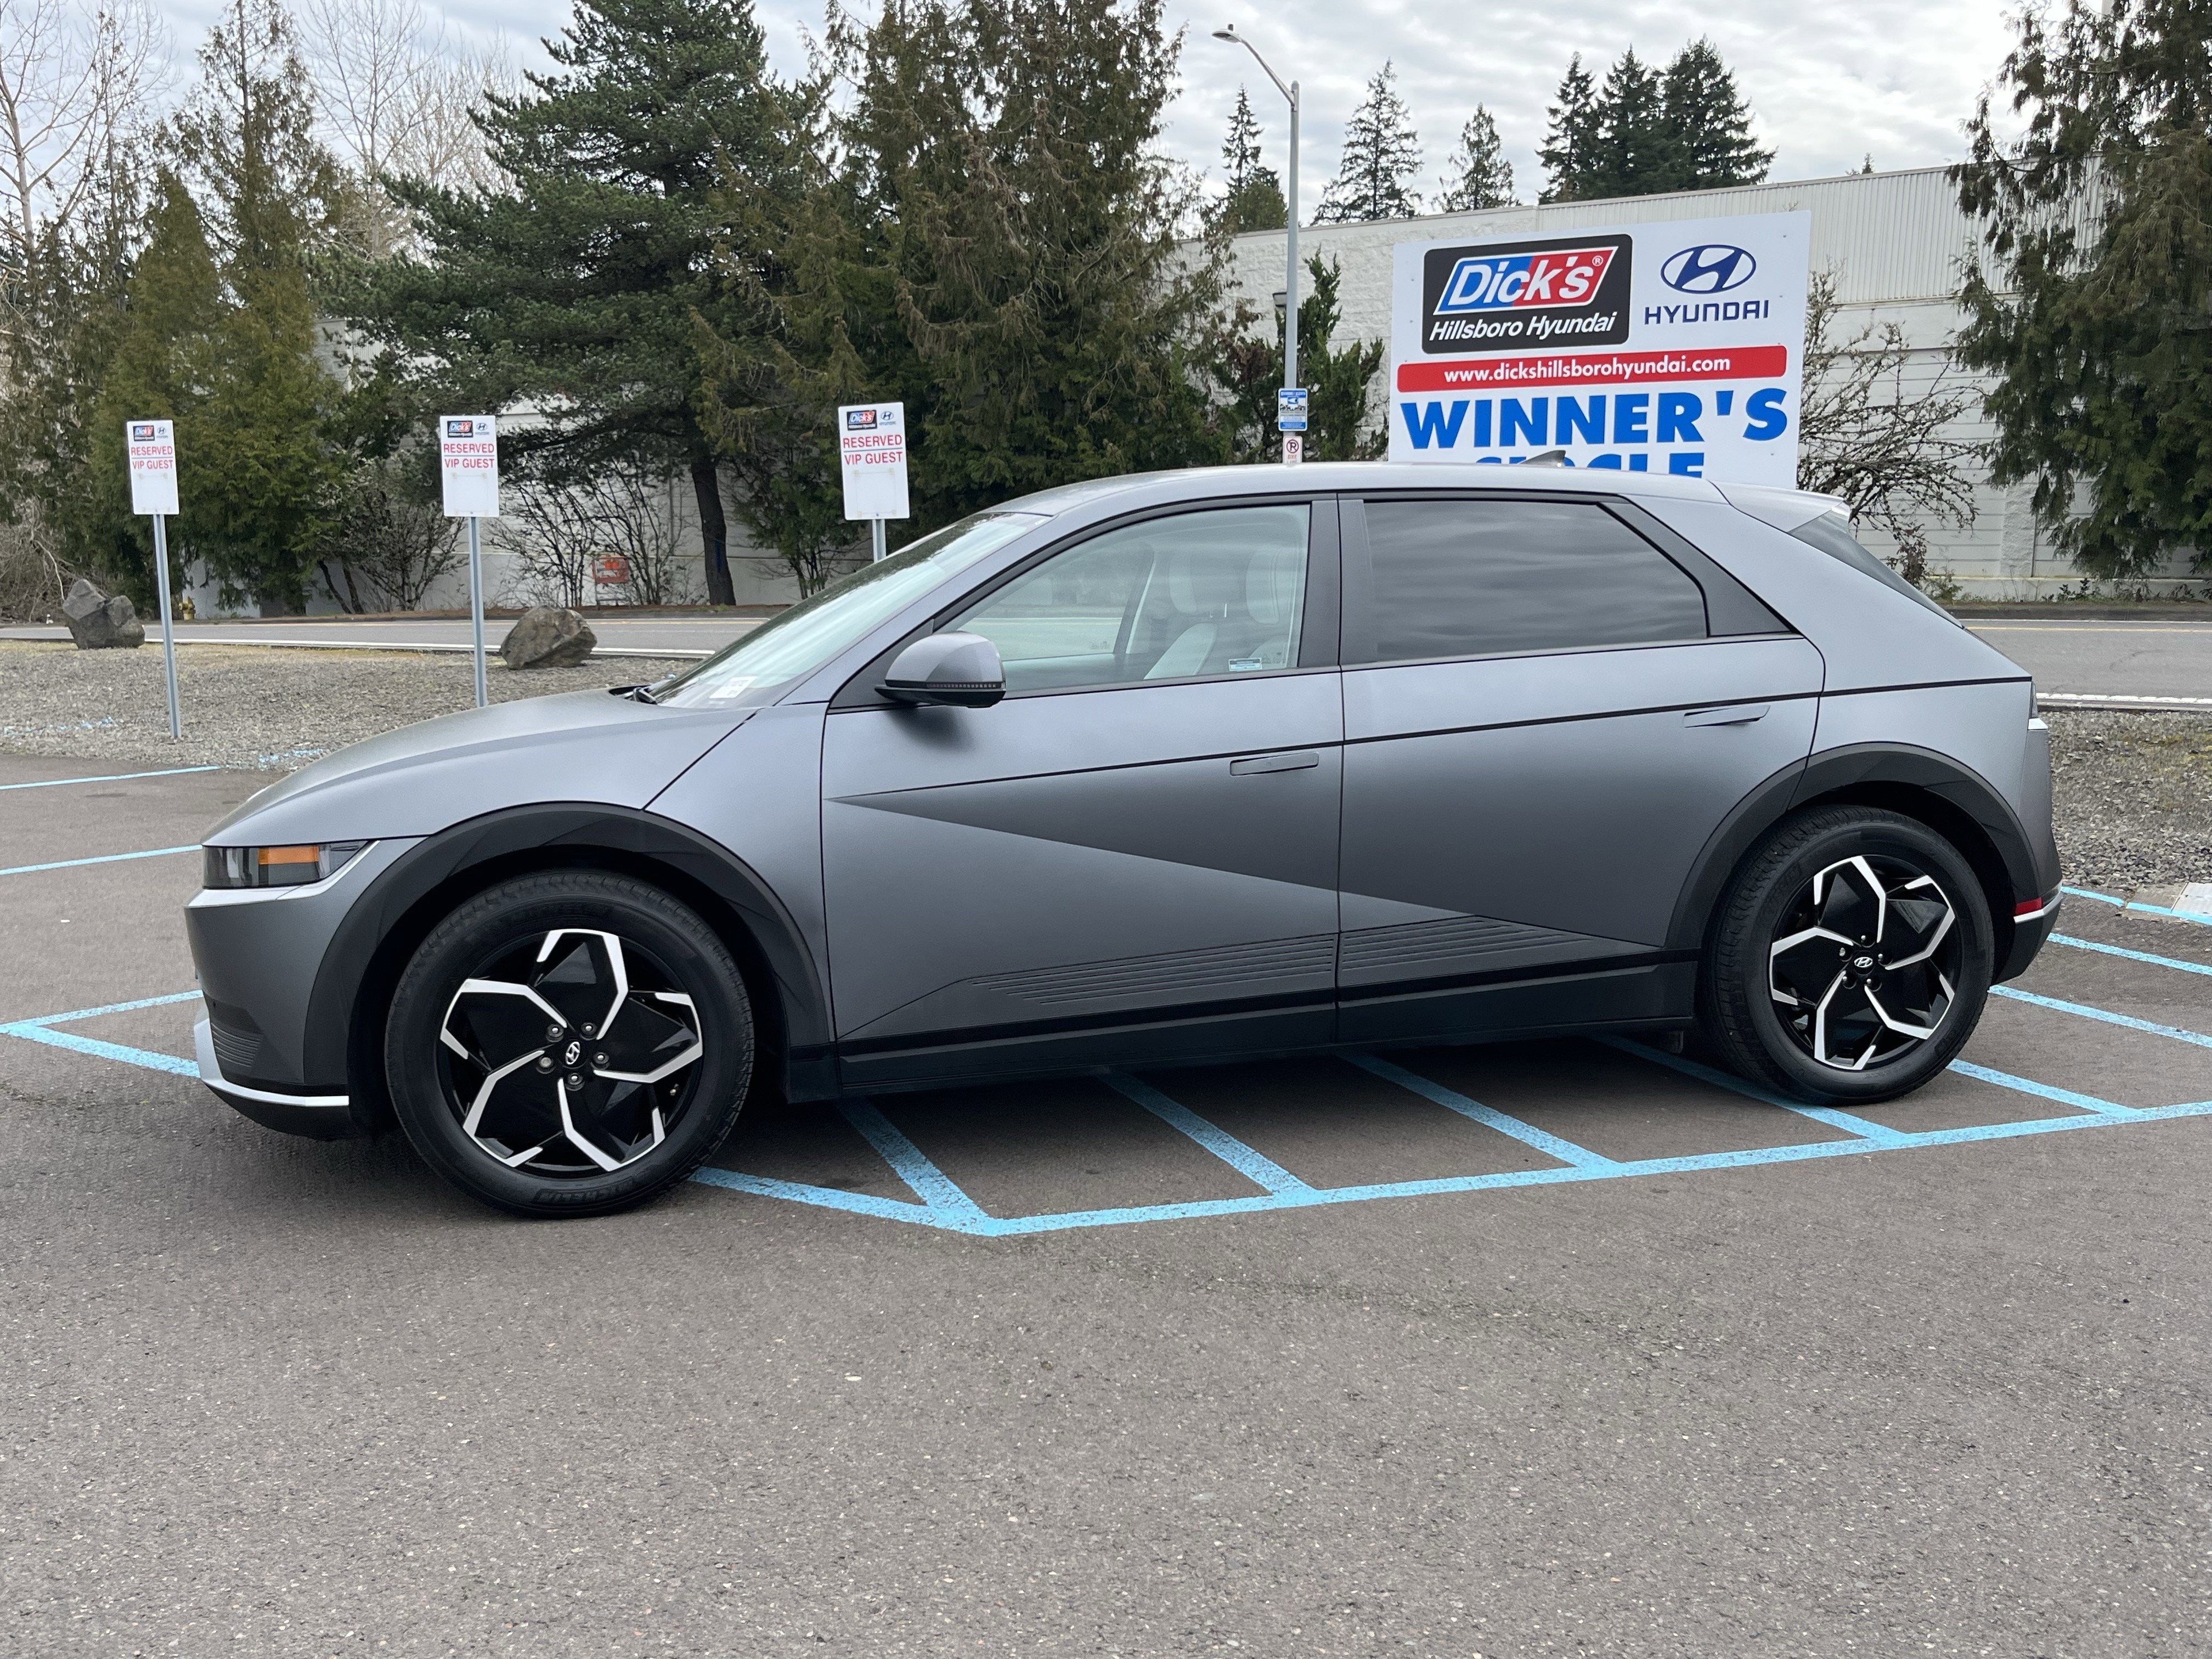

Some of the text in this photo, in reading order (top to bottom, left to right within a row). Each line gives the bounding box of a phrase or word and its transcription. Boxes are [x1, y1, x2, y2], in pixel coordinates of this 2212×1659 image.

[1644, 300, 1769, 325] HYUNDAI
[1429, 312, 1617, 341] Hillsboro Hyundai
[1444, 354, 1730, 383] www.dickshillsborohyundai.com
[1400, 388, 1787, 449] WINNER'S
[443, 443, 494, 454] RESERVED
[843, 434, 902, 449] RESERVED
[131, 445, 173, 456] RESERVED
[132, 459, 173, 470] VIP GUEST
[444, 458, 495, 469] VIP GUEST
[844, 452, 903, 465] VIP GUEST
